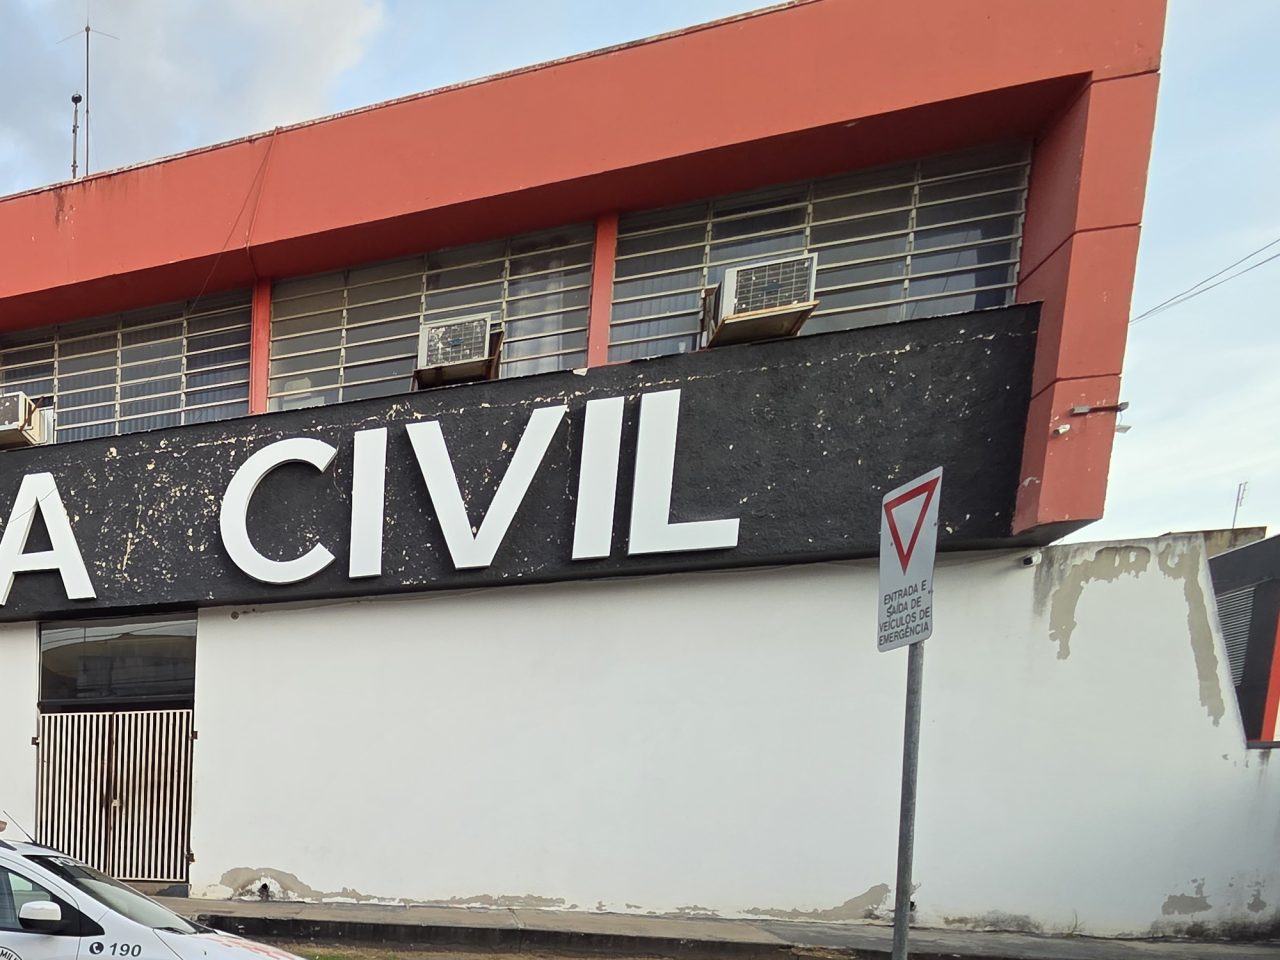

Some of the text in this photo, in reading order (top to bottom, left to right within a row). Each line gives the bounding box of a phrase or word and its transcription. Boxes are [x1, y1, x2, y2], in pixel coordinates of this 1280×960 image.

[219, 388, 741, 584] CIVIL
[883, 579, 927, 606] ENTRADA E
[879, 606, 931, 633] VEÍCULOS DE
[886, 595, 922, 618] SAÍDA DE
[878, 621, 929, 646] EMERGÊNCIA
[110, 942, 142, 957] 190
